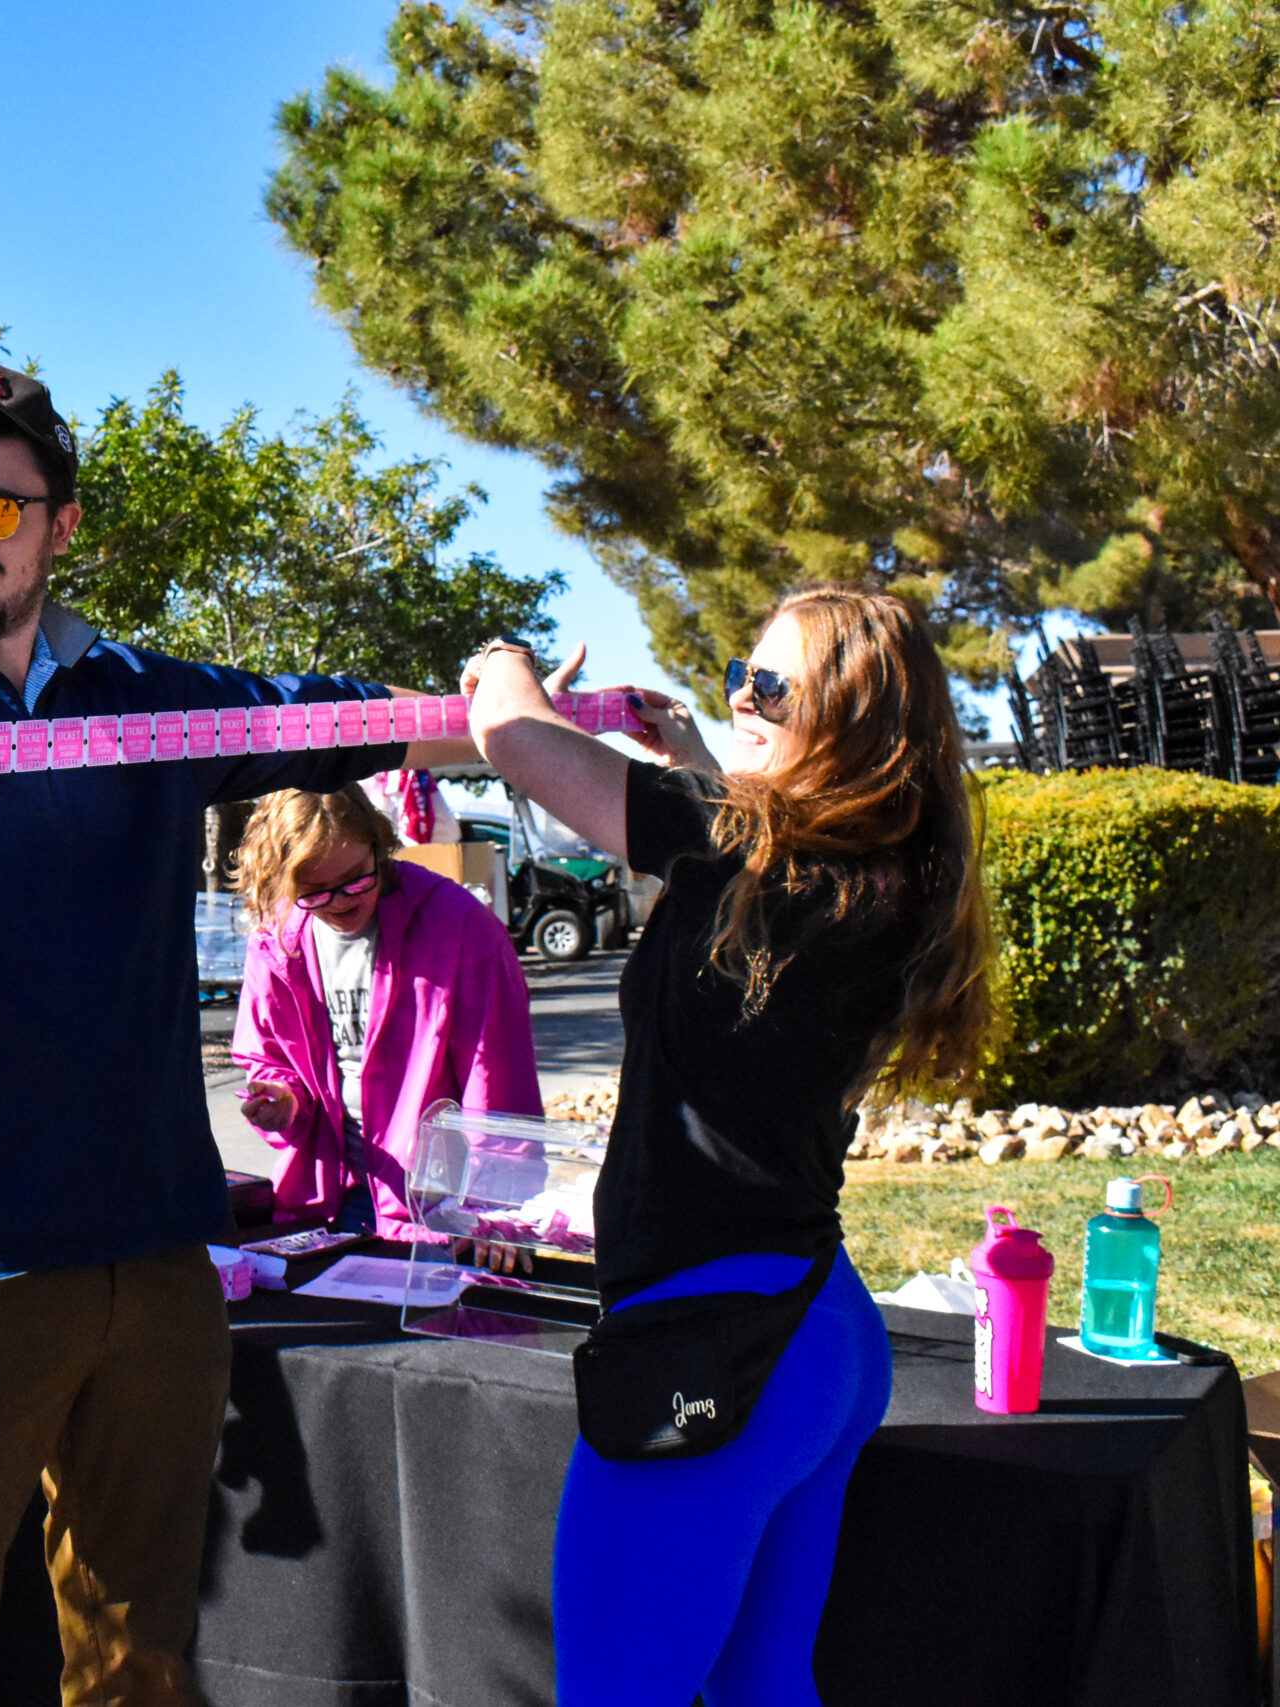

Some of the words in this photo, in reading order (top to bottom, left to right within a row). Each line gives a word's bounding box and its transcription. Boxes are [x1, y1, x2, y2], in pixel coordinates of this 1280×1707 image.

[159, 724, 180, 734] TICKET
[191, 722, 212, 732] TICKET
[223, 720, 243, 729] TICKET
[57, 730, 80, 741] TICKET
[92, 728, 115, 738] TICKET
[126, 726, 148, 736] TICKET
[21, 733, 45, 743] TICKET
